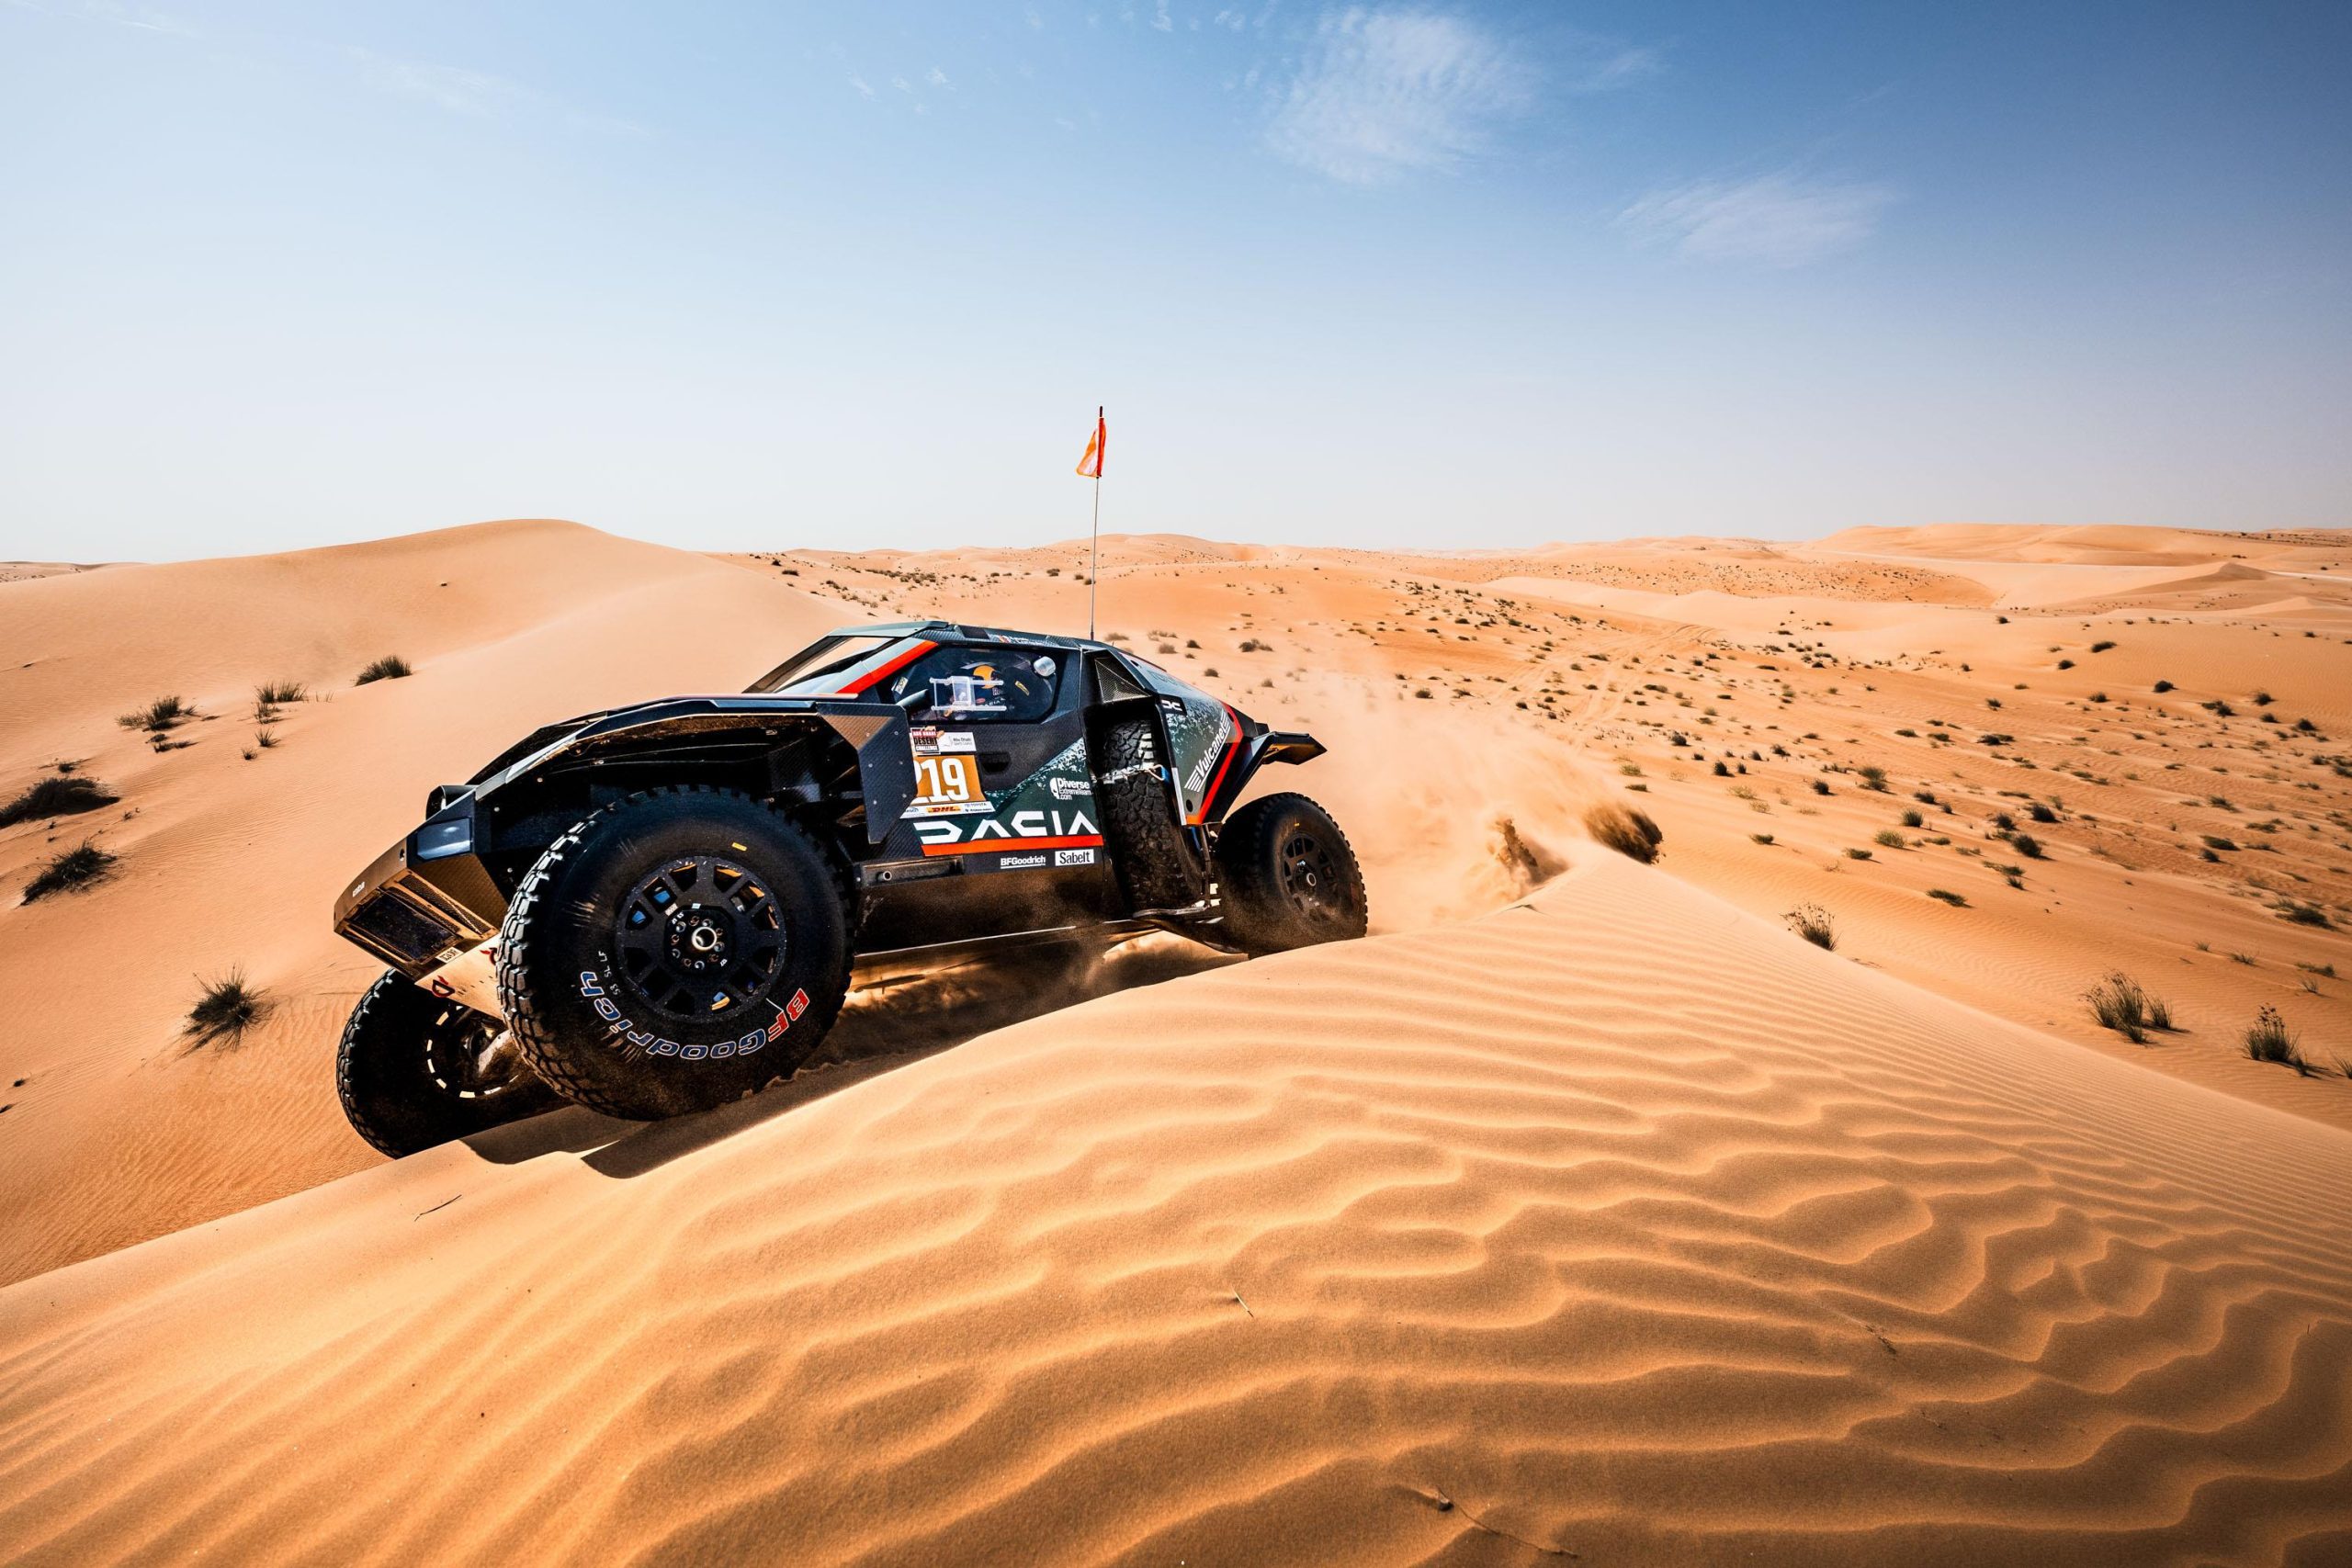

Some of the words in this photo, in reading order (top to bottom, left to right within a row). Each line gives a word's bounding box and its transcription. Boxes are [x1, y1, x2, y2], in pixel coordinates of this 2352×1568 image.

[913, 737, 937, 745] DESERT
[1193, 718, 1228, 780] Vulcanet
[1057, 778, 1091, 790] Diverse
[913, 811, 1101, 844] DACIA
[1001, 855, 1046, 867] BFGoodrich
[1059, 852, 1091, 865] Sabelt
[581, 972, 810, 1060] BFGoodrich
